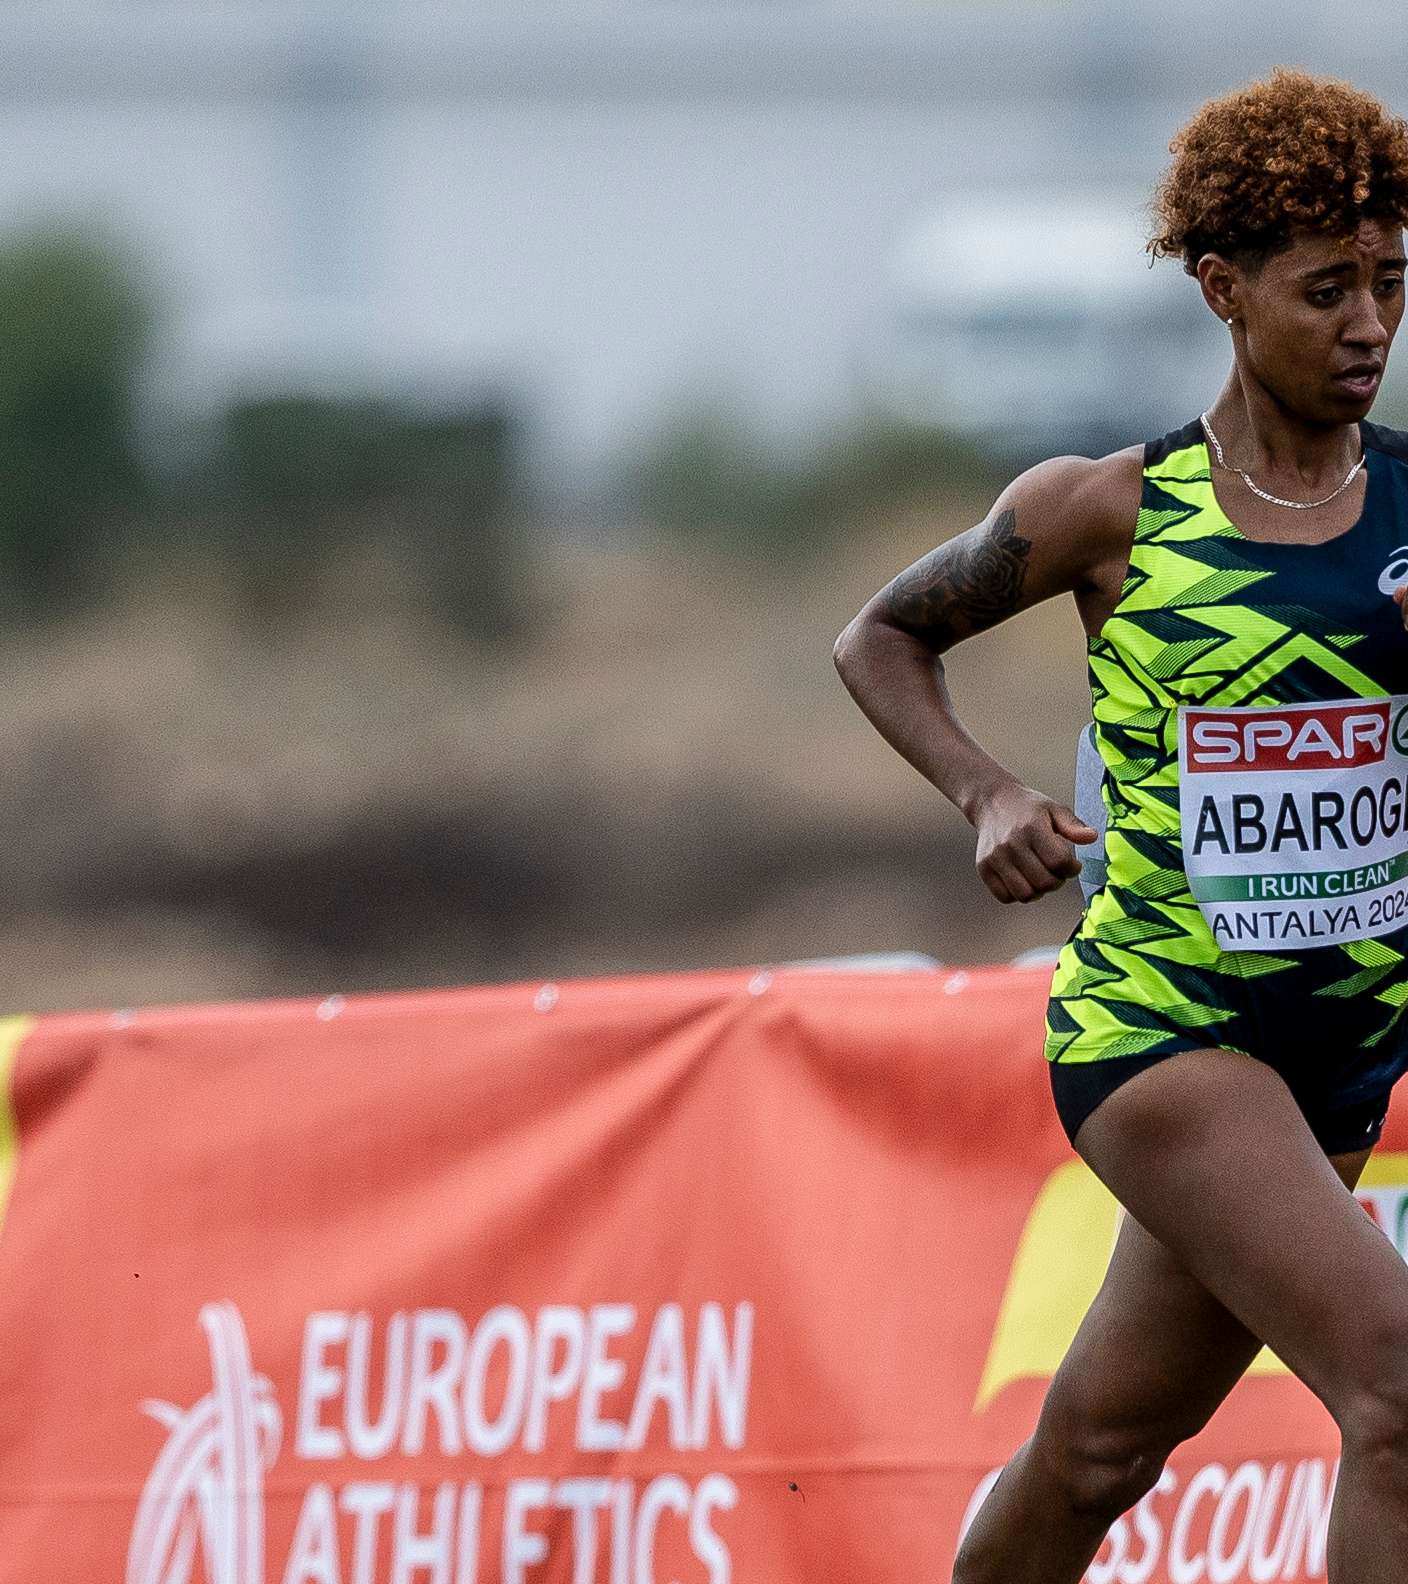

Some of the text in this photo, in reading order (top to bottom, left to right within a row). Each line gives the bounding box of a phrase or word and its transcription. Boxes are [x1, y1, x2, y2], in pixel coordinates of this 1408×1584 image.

[1191, 711, 1386, 764] SPAR
[1247, 877, 1255, 897] I
[1261, 873, 1318, 897] RUN
[1211, 906, 1361, 942] ANTALYA
[296, 1301, 754, 1459] EUROPEAN
